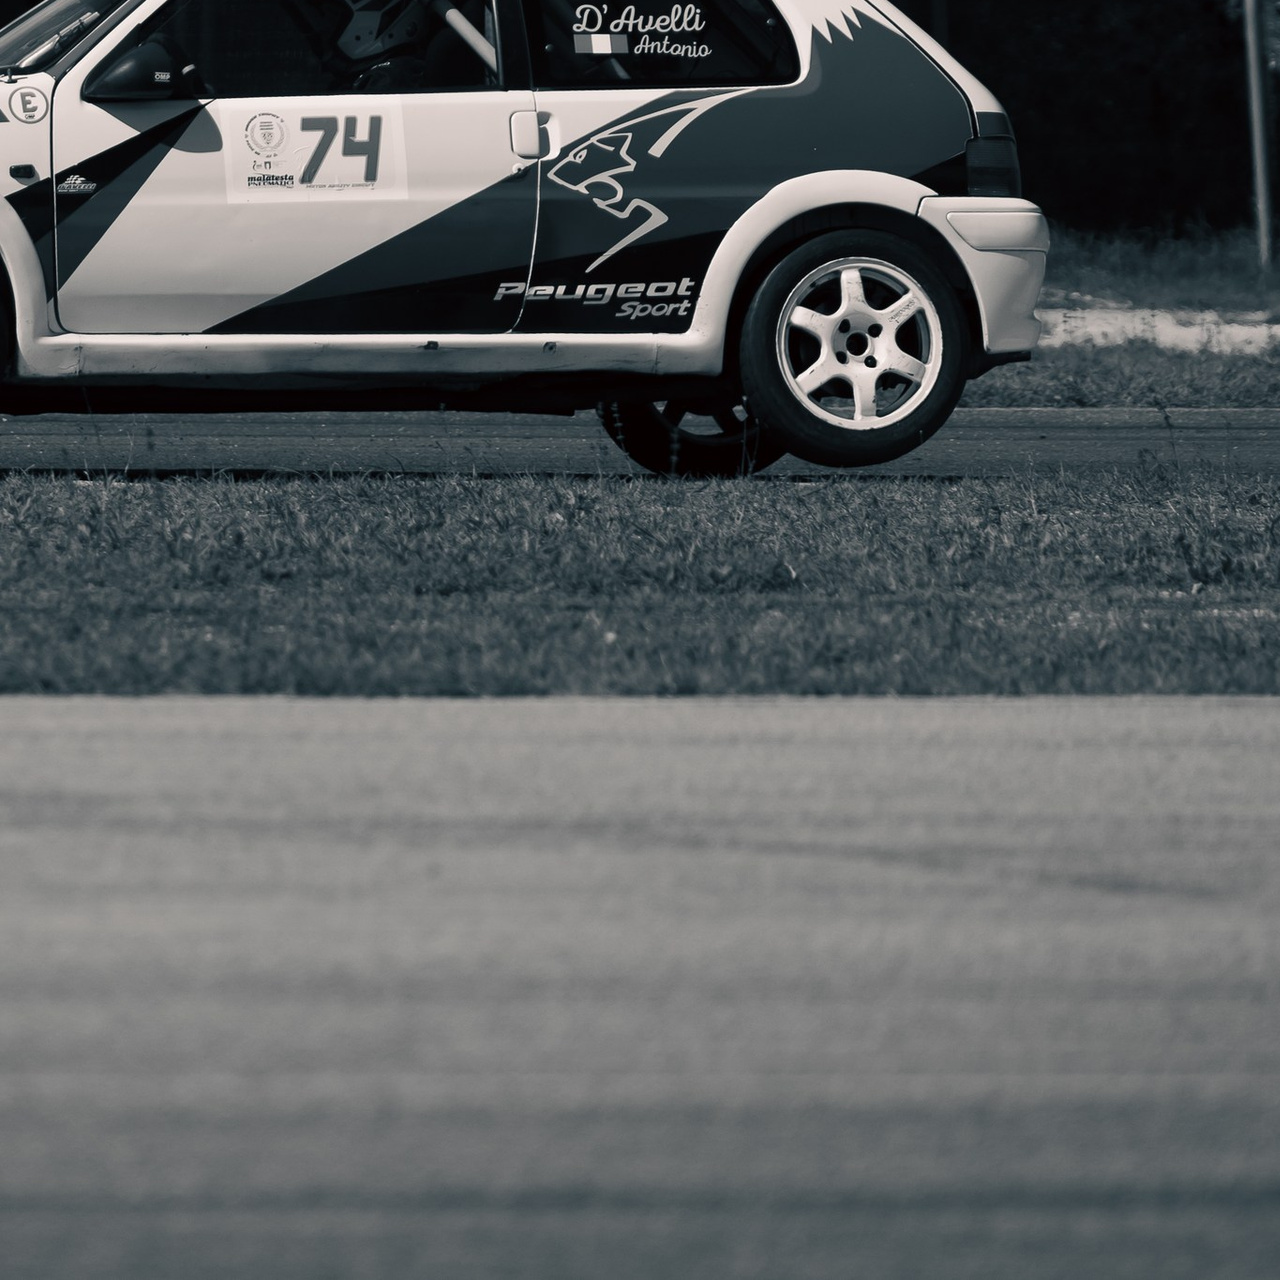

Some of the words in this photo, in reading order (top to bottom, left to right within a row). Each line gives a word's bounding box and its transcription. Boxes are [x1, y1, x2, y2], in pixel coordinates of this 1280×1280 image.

[634, 34, 712, 58] Antonio
[20, 91, 38, 113] E
[299, 115, 382, 184] 74
[248, 174, 294, 182] malatesta
[493, 277, 695, 305] Peugeot
[615, 299, 691, 320] Sport
